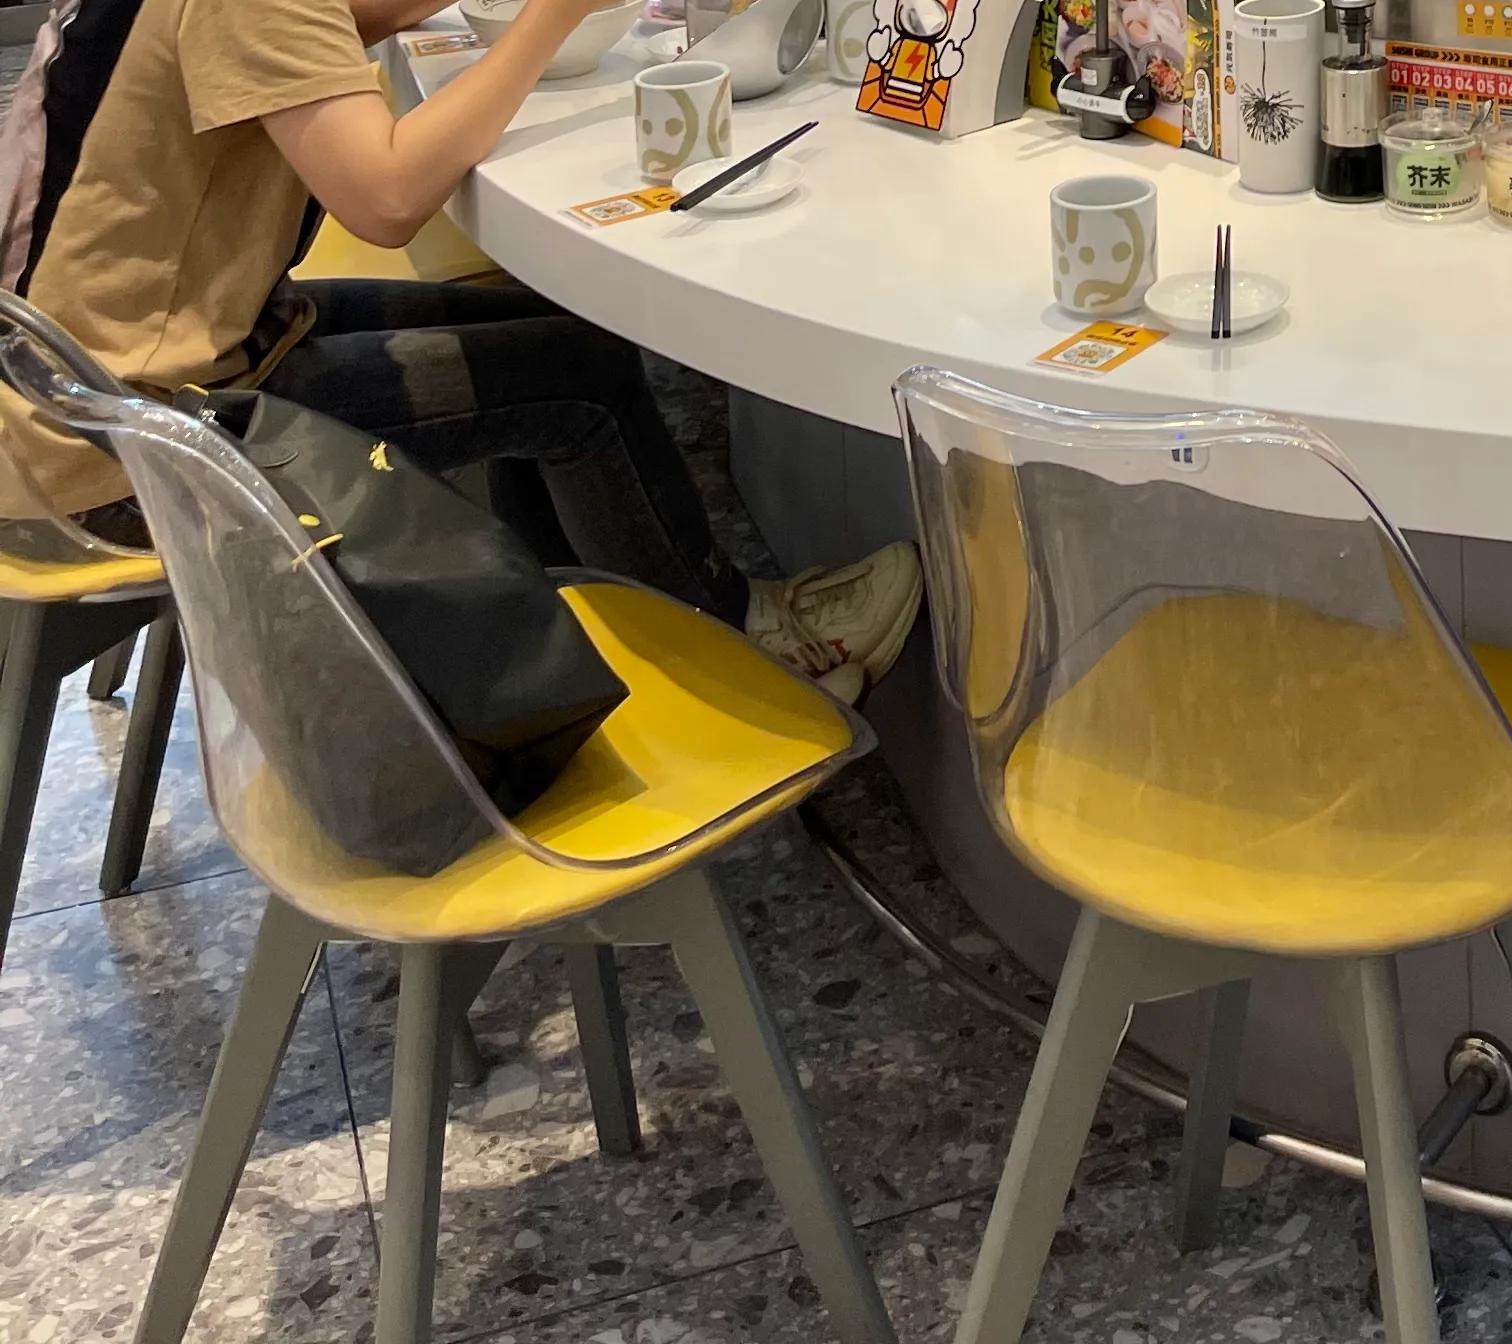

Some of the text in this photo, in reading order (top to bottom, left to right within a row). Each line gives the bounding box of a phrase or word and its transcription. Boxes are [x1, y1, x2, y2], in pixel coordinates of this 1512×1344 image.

[1391, 71, 1408, 84] 01
[1412, 73, 1430, 87] 02
[1433, 74, 1451, 89] 03
[1455, 76, 1473, 92] 04
[1477, 79, 1495, 94] 05
[1406, 164, 1452, 188] 芥末
